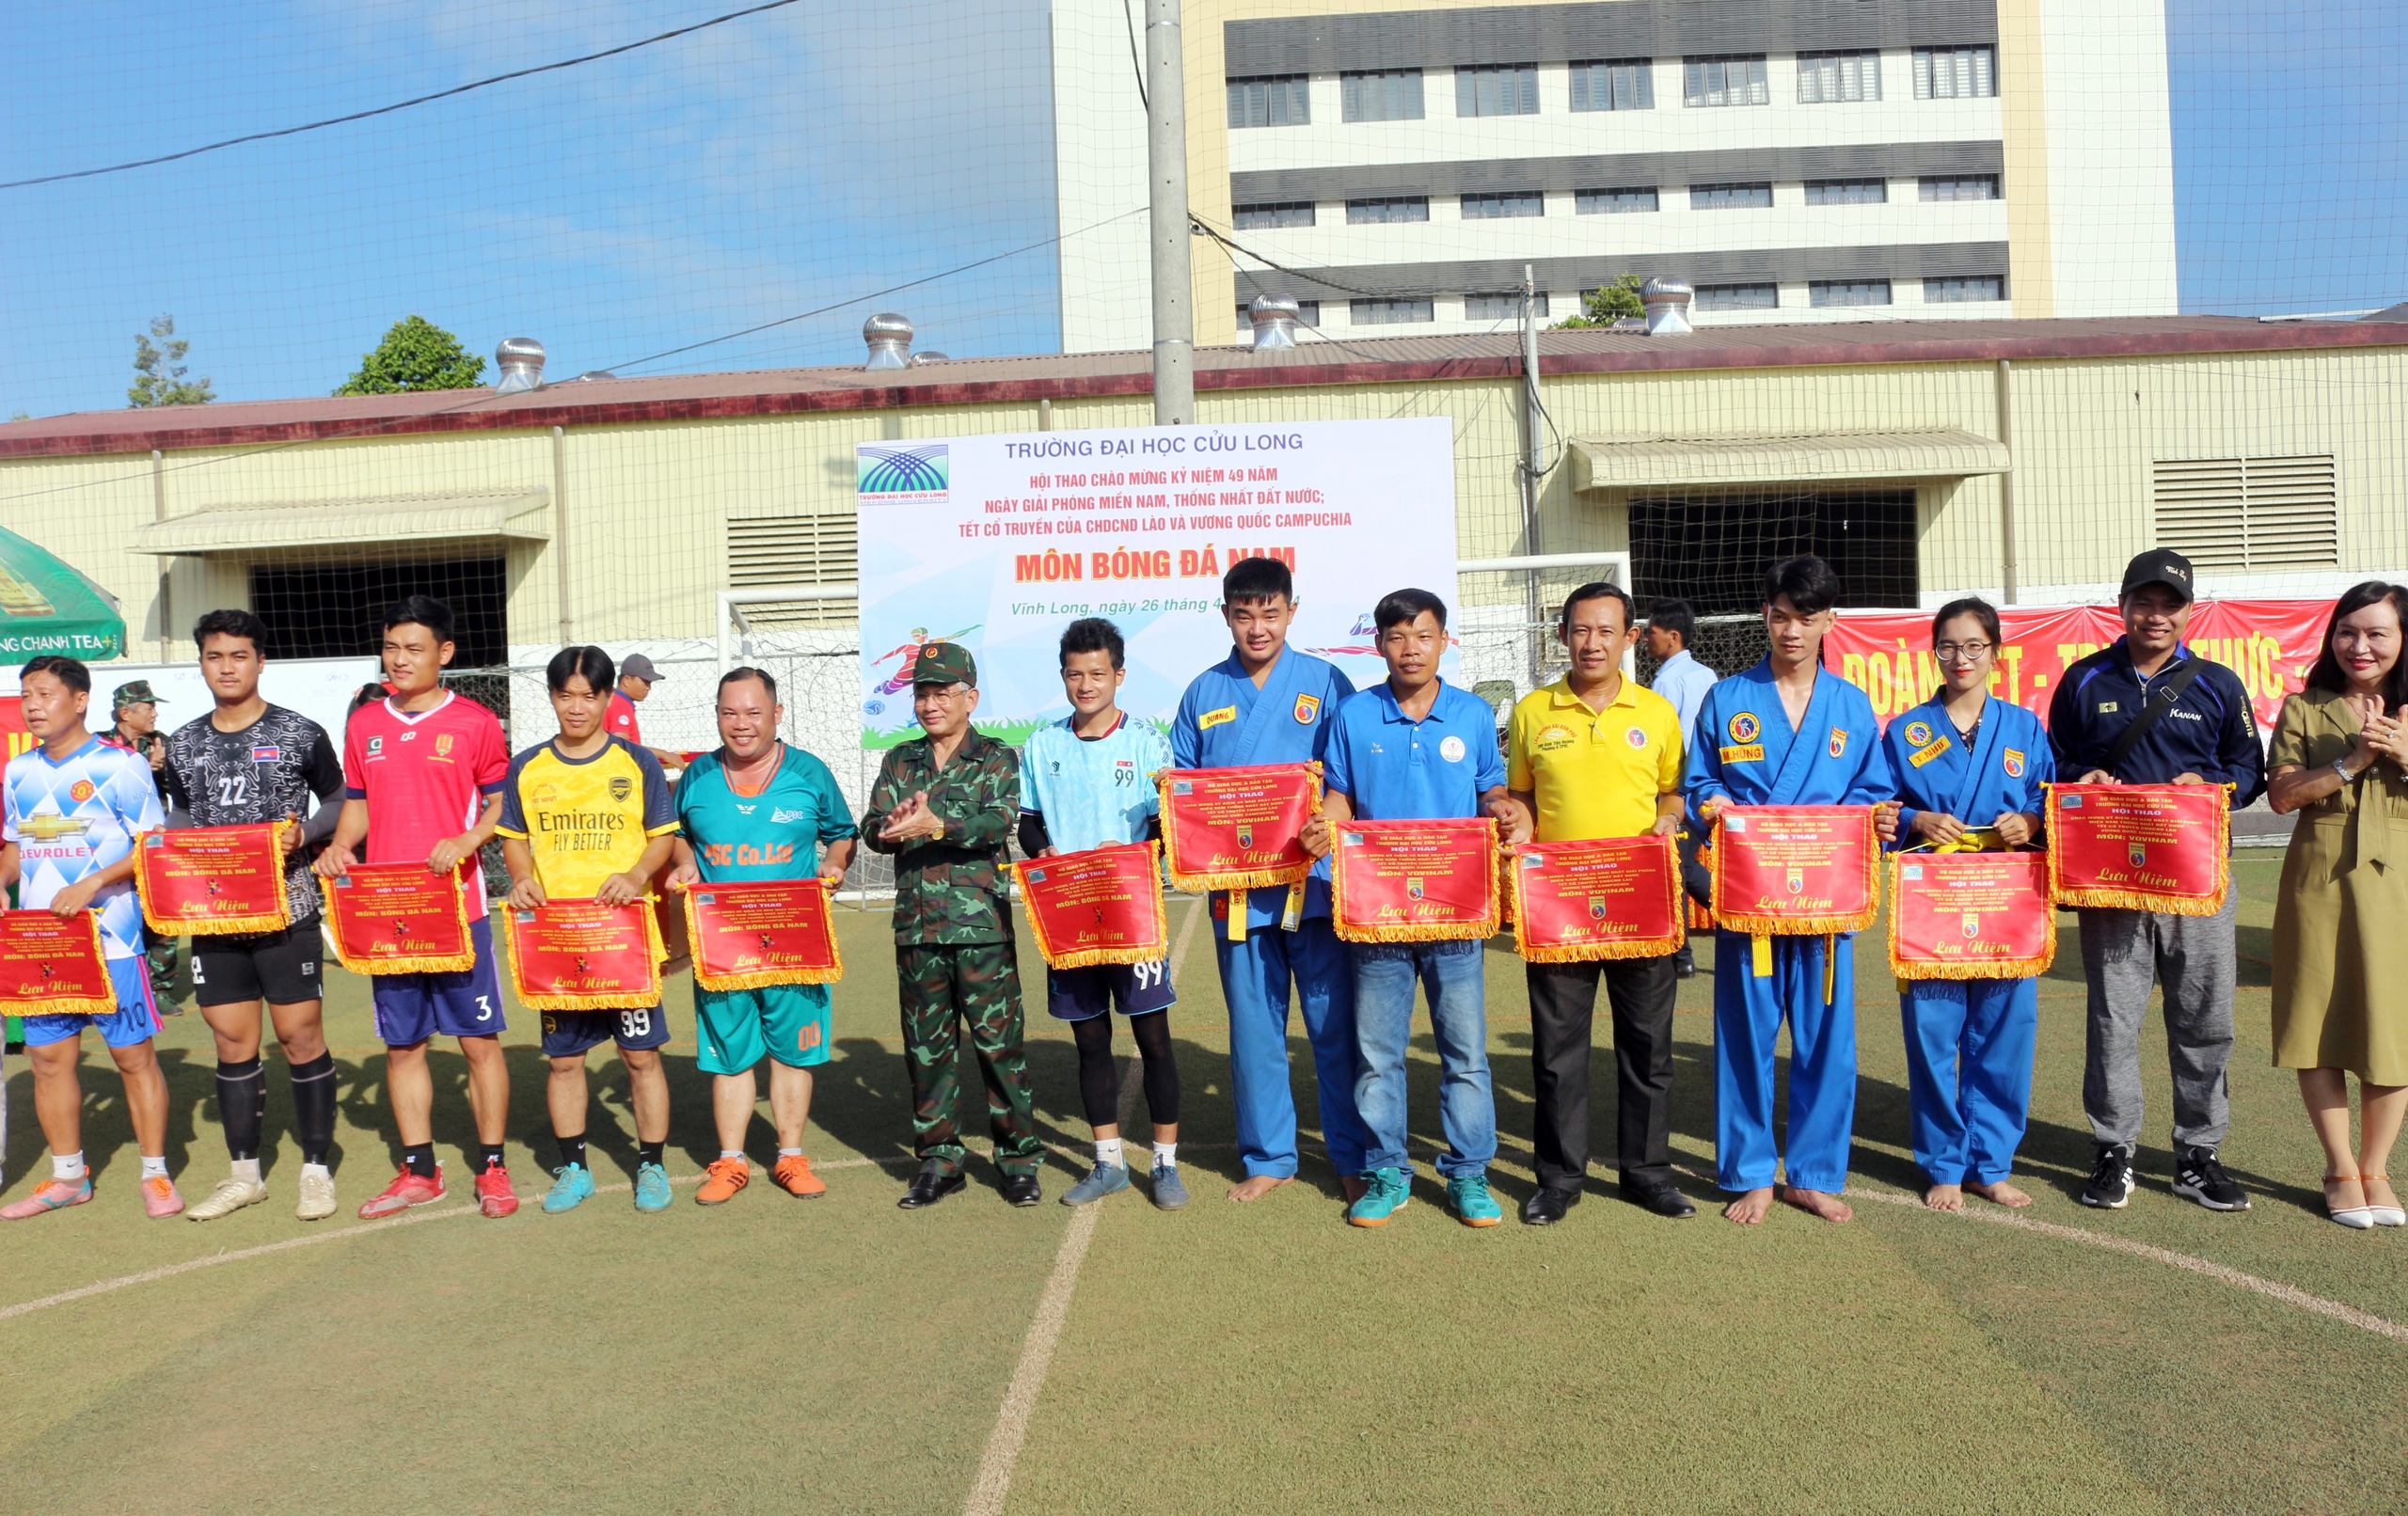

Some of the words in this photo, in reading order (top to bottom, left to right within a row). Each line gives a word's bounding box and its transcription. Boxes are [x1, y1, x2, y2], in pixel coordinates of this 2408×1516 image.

[1006, 438, 1093, 459] TRƯỜNG
[1101, 438, 1134, 458] ĐẠI
[1142, 437, 1186, 456] HỌC
[1195, 430, 1237, 452] CỬU
[1245, 434, 1303, 450] LONG
[1030, 474, 1051, 491] HỘI
[1055, 474, 1087, 487] THAO
[1090, 472, 1124, 486] CHÀO
[1129, 469, 1166, 485] MỪNG
[1171, 466, 1187, 483] KỶ
[1191, 468, 1224, 485] NIỆM
[1228, 469, 1244, 482] 49
[1248, 466, 1278, 482] NĂM
[985, 498, 1018, 513] NGÀY
[1022, 494, 1048, 513] GIẢI
[1052, 495, 1095, 511] PHÓNG
[1100, 495, 1132, 509] MIỀN
[1136, 495, 1169, 509] NAM,
[1174, 489, 1215, 507] THỐNG
[1220, 486, 1253, 506] NHẤT
[1258, 486, 1281, 504] ĐẤT
[1286, 489, 1324, 504] NƯỚC;
[959, 521, 979, 537] TẾT
[984, 518, 1001, 536] CỔ
[1005, 520, 1053, 536] TRUYỀN
[1056, 517, 1082, 533] CỦA
[1085, 519, 1138, 532] CHDCND
[1142, 514, 1165, 531] LÀO
[1170, 514, 1186, 530] VÀ
[1190, 514, 1232, 529] VƯƠNG
[1237, 510, 1271, 529] QUỐC
[1275, 513, 1352, 527] CAMPUCHIA
[1015, 548, 1083, 582] MÔN
[1091, 545, 1171, 580] BÓNG
[1179, 544, 1219, 576] ĐÁ
[1011, 602, 1044, 616] Vĩnh
[1051, 602, 1093, 616] Long,
[1099, 601, 1136, 614] ngày
[1142, 599, 1158, 611] 26
[1164, 598, 1201, 611] tháng
[1207, 597, 1221, 609] 4
[22, 636, 70, 651] CHANH
[2169, 708, 2202, 721] KANAN
[1723, 747, 1761, 761] M.HÙNG
[1115, 768, 1133, 787] 99
[219, 776, 246, 806] 22
[539, 809, 624, 831] Emirates
[786, 811, 803, 819] PSC
[1237, 815, 1279, 824] VOVINAM
[554, 834, 569, 851] FLY
[573, 833, 611, 850] BETTER
[2130, 835, 2178, 844] VOVINAM
[20, 846, 94, 859] EVROLET
[1209, 852, 1238, 865] Lưu
[2096, 867, 2128, 881] Lưu
[1377, 904, 1408, 917] Lưu
[1755, 895, 1786, 909] Lưu
[1793, 895, 1832, 911] Niệm
[1560, 924, 1591, 938] Lưu
[1932, 940, 1962, 954] Lưu
[1133, 960, 1163, 990] 99
[122, 1002, 146, 1032] 10
[475, 995, 492, 1021] 3
[621, 1008, 651, 1037] 99
